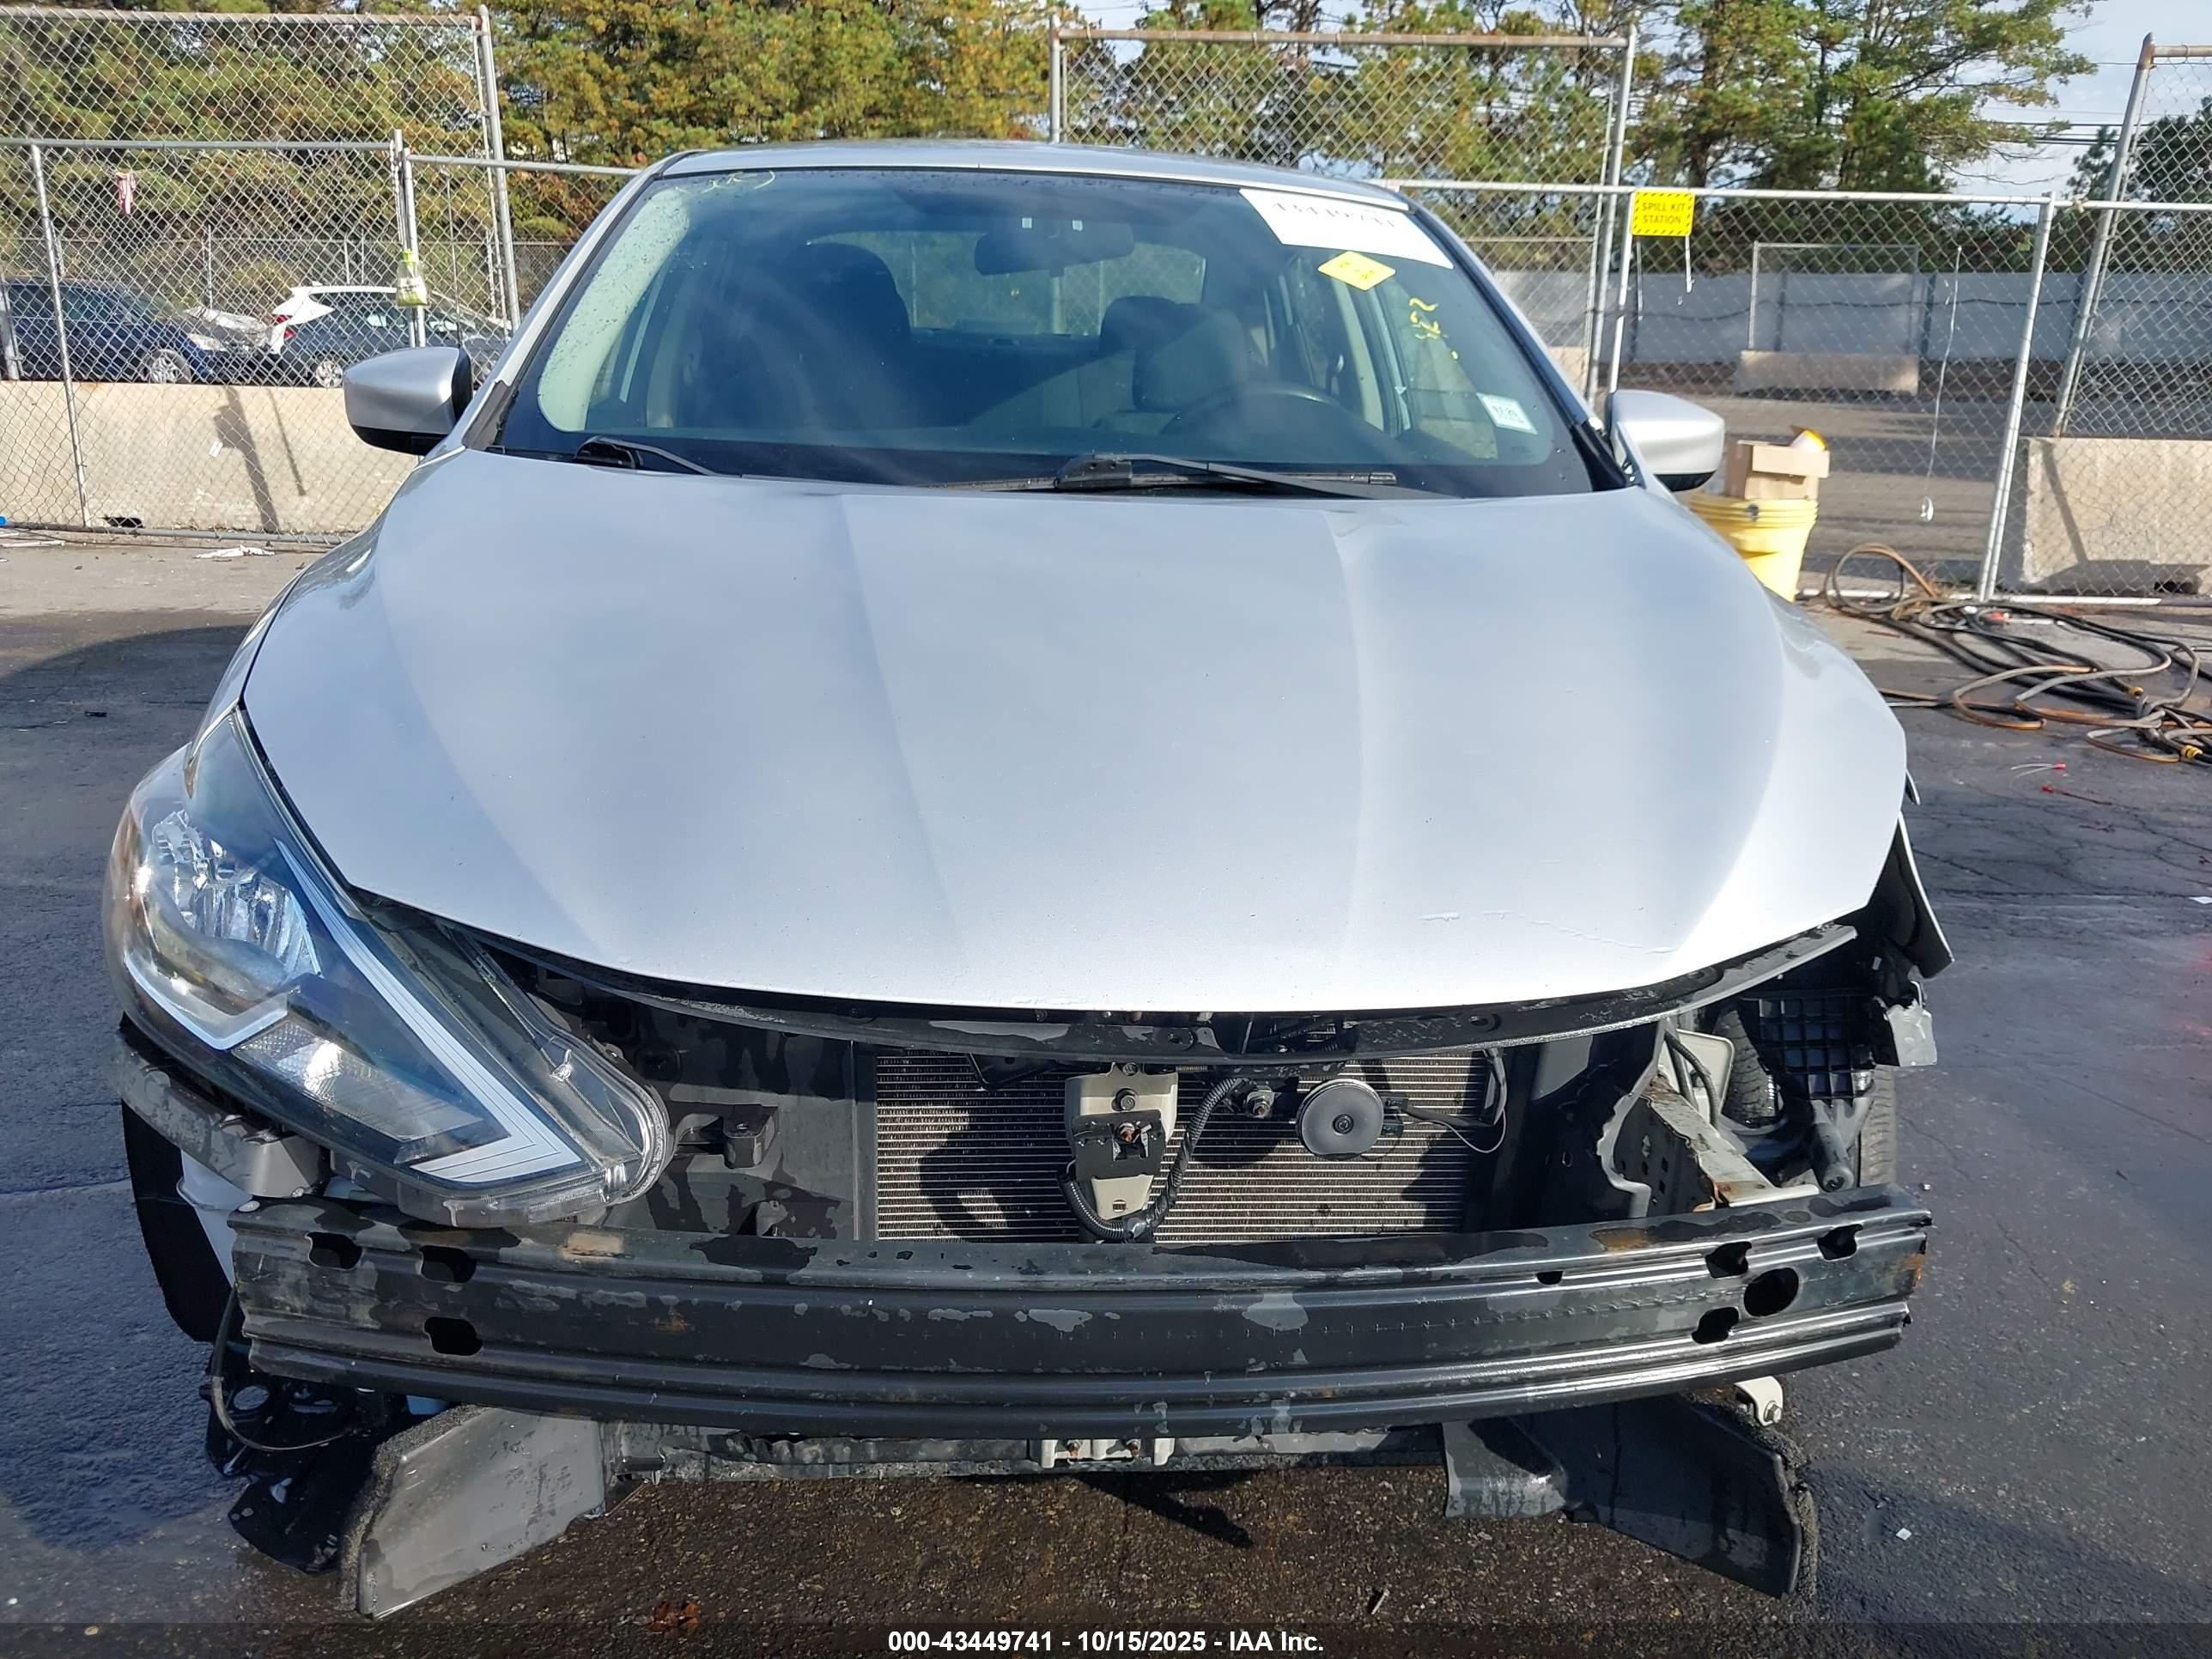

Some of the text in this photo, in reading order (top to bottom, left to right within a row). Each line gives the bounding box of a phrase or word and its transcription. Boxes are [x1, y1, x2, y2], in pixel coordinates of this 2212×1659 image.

[1641, 202, 1686, 212] SPILL KIT
[1642, 215, 1681, 224] STATION
